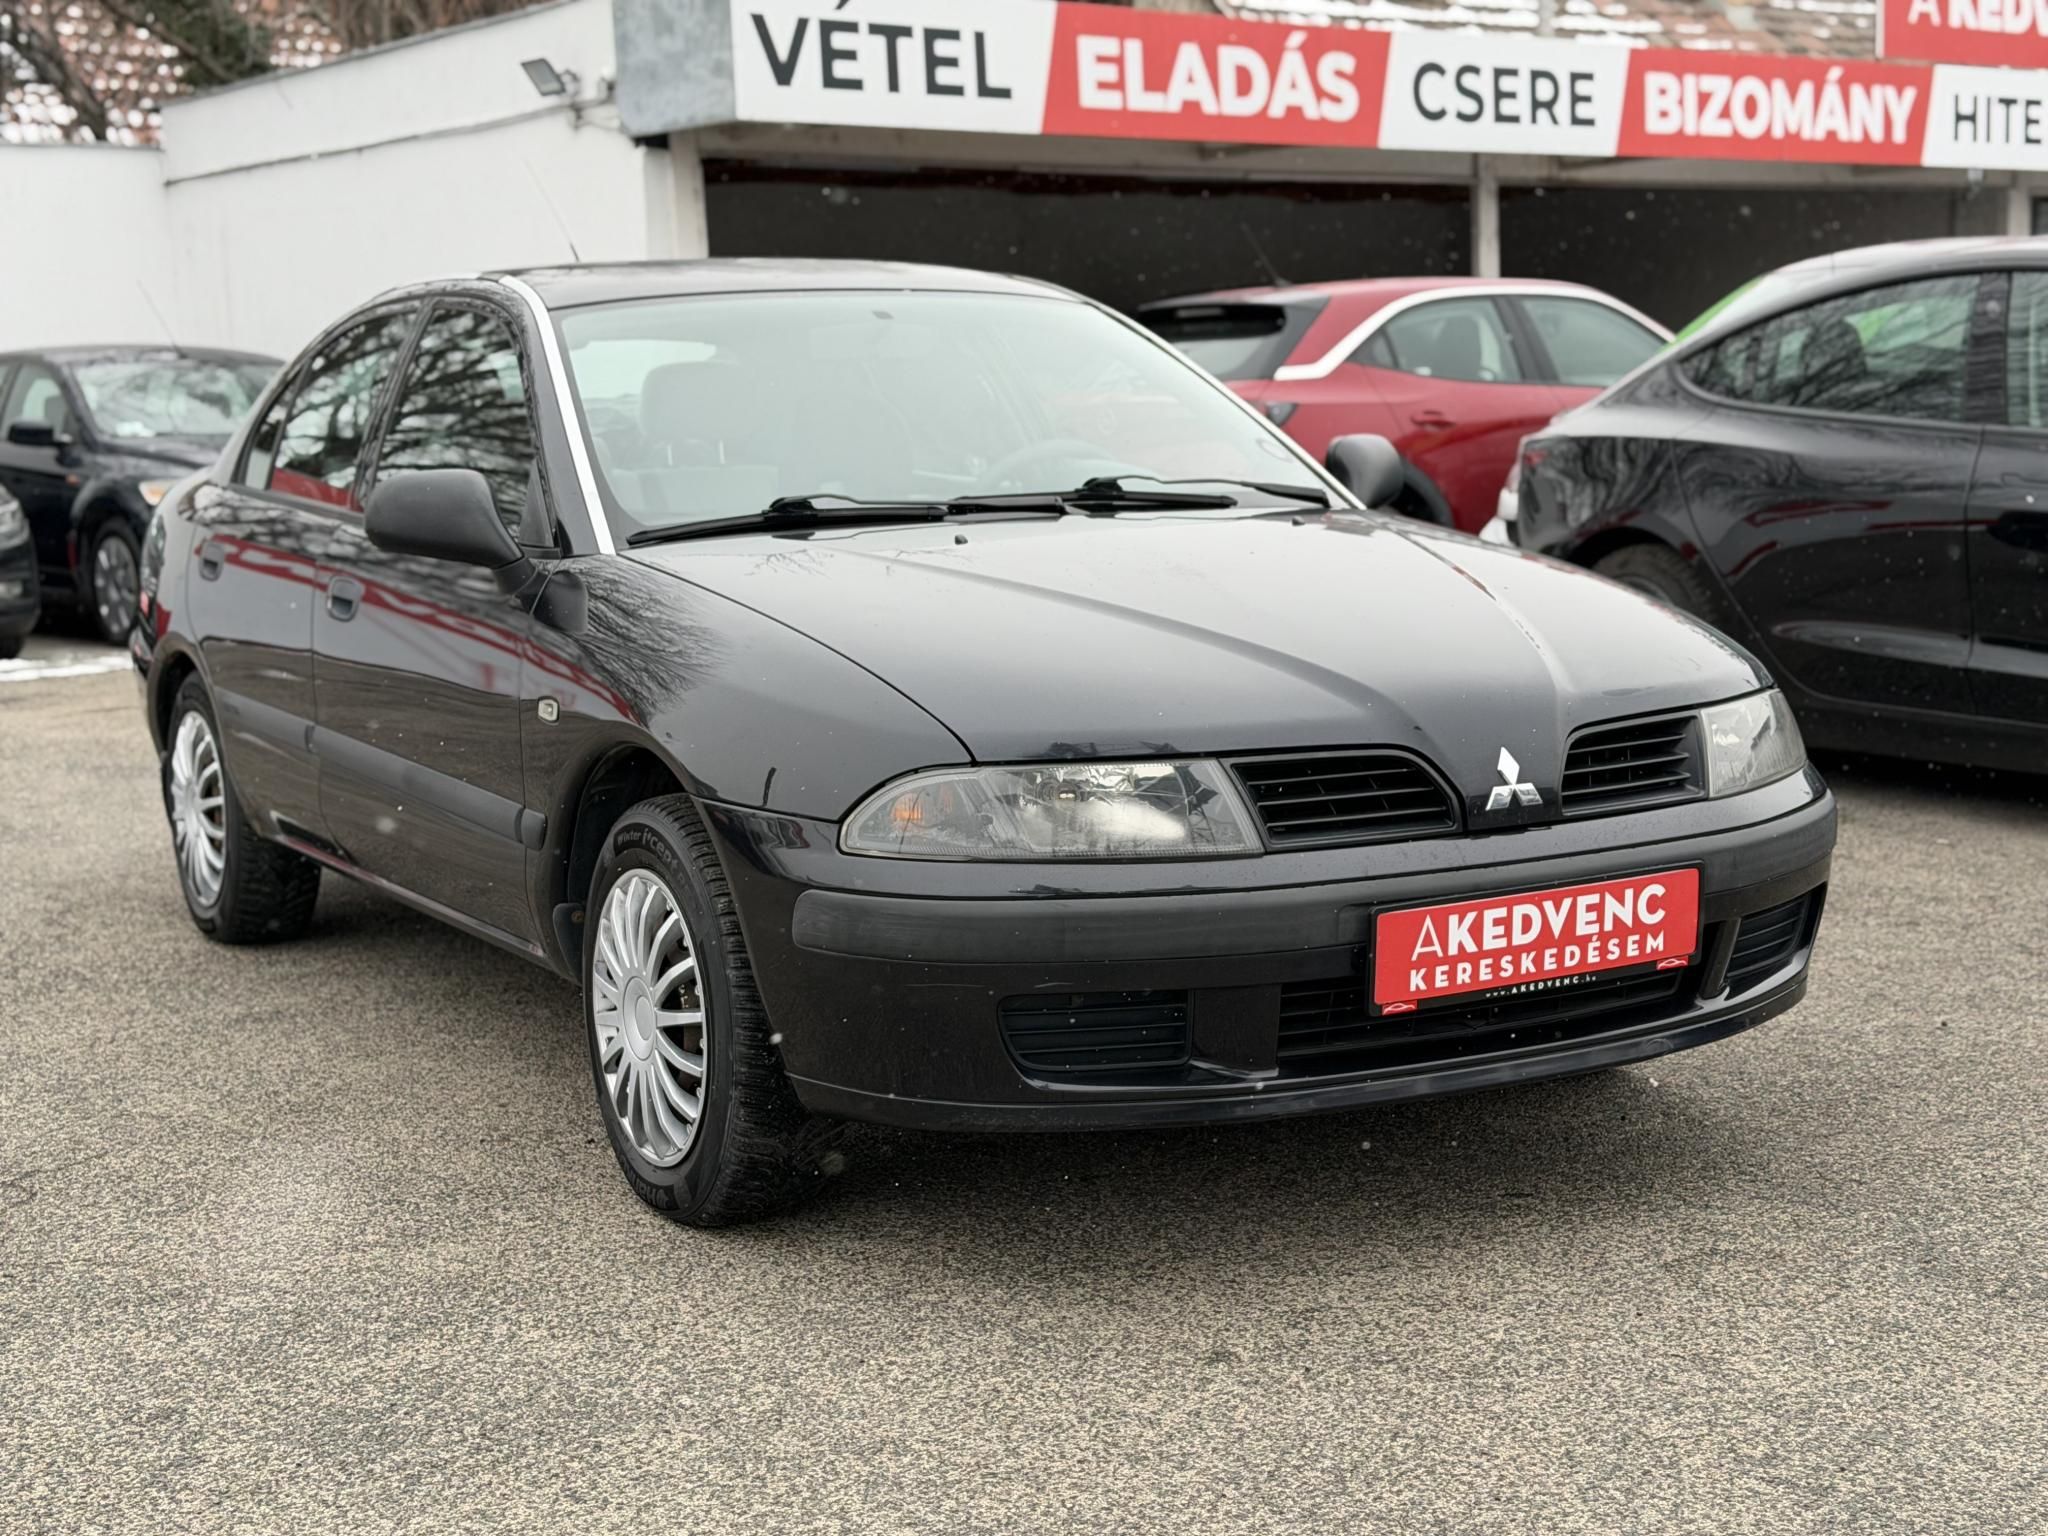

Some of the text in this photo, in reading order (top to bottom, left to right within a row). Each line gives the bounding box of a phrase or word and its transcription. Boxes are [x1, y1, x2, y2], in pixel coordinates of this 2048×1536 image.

[1948, 0, 2048, 37] KED
[751, 0, 1012, 100] VÉTEL
[1076, 32, 1360, 122] ELADÁS
[1413, 62, 1596, 127] CSERE
[1643, 68, 1918, 145] BIZOMÁNY
[1409, 930, 1665, 992] KERESKEDÉSEM
